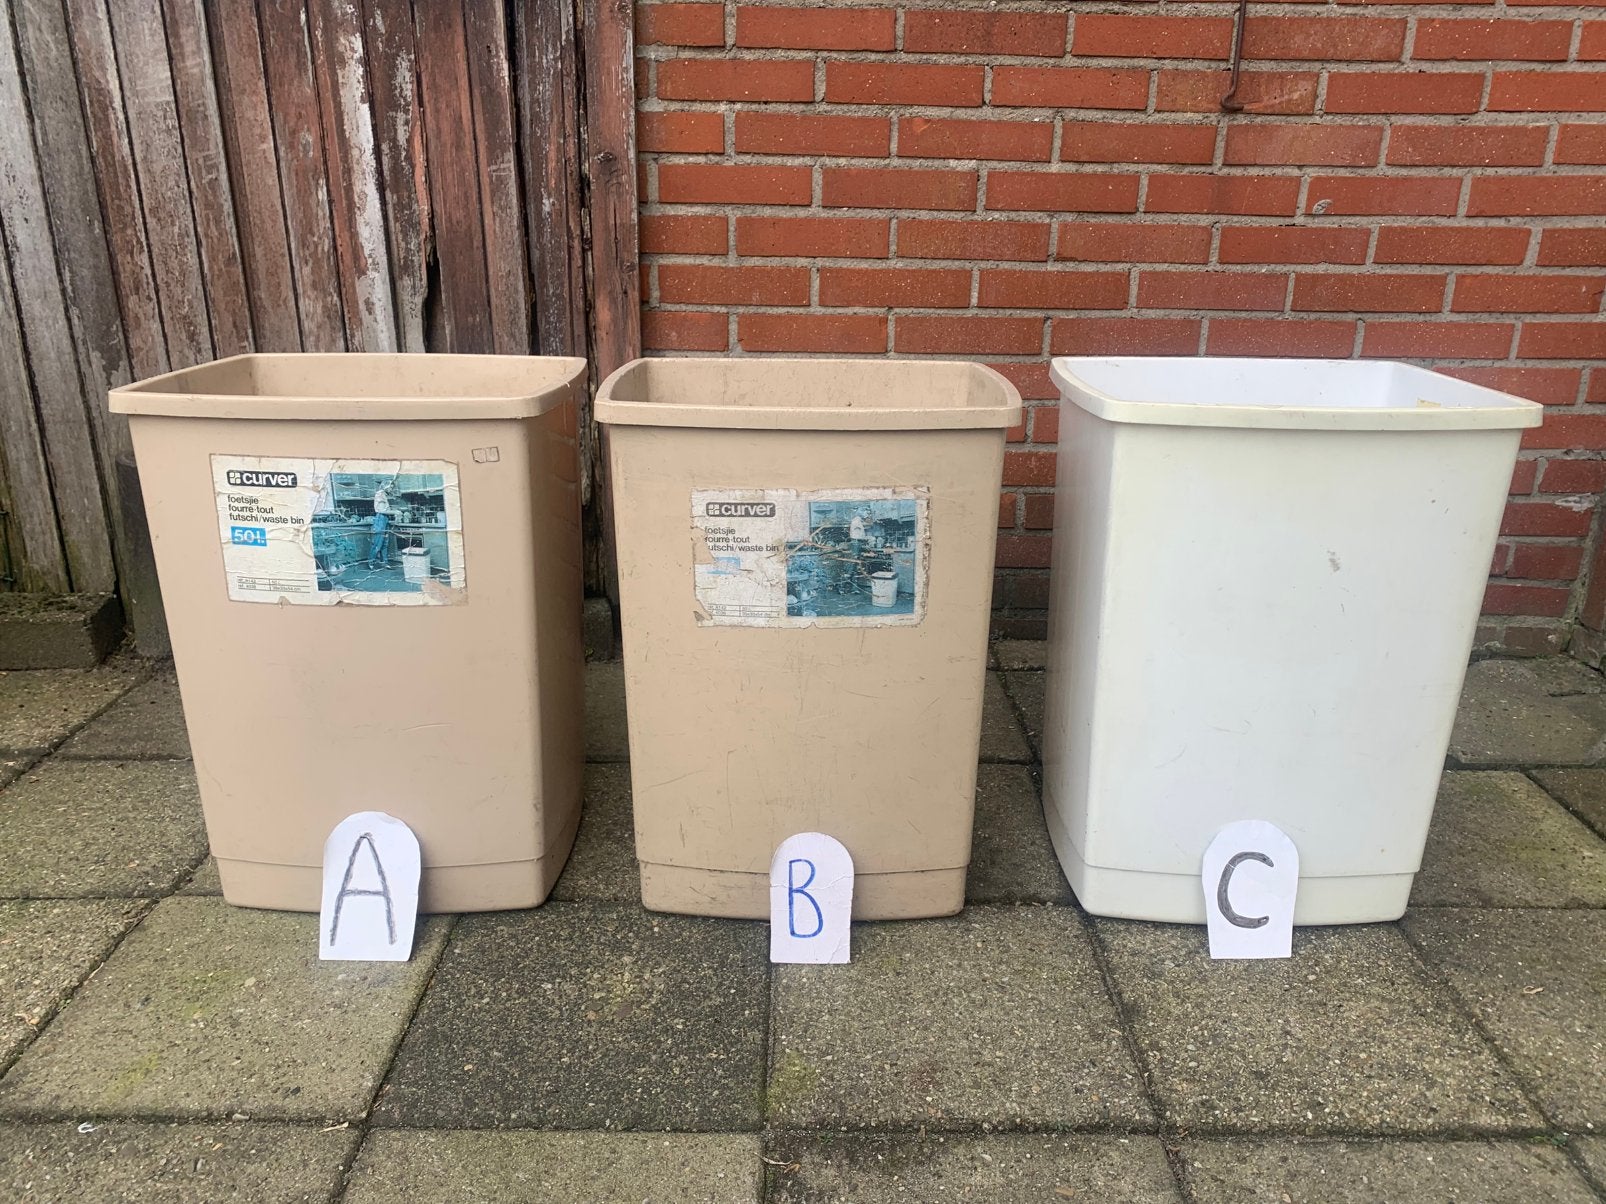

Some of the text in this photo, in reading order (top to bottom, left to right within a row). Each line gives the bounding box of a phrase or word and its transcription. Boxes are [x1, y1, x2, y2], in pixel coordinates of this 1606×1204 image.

[242, 472, 295, 486] curver
[227, 494, 259, 505] foetsjie
[721, 504, 774, 516] curver
[290, 516, 305, 525] bin
[708, 544, 779, 552] utschi/waste bin
[330, 832, 398, 947] A
[1217, 851, 1274, 929] C
[788, 858, 823, 938] B
